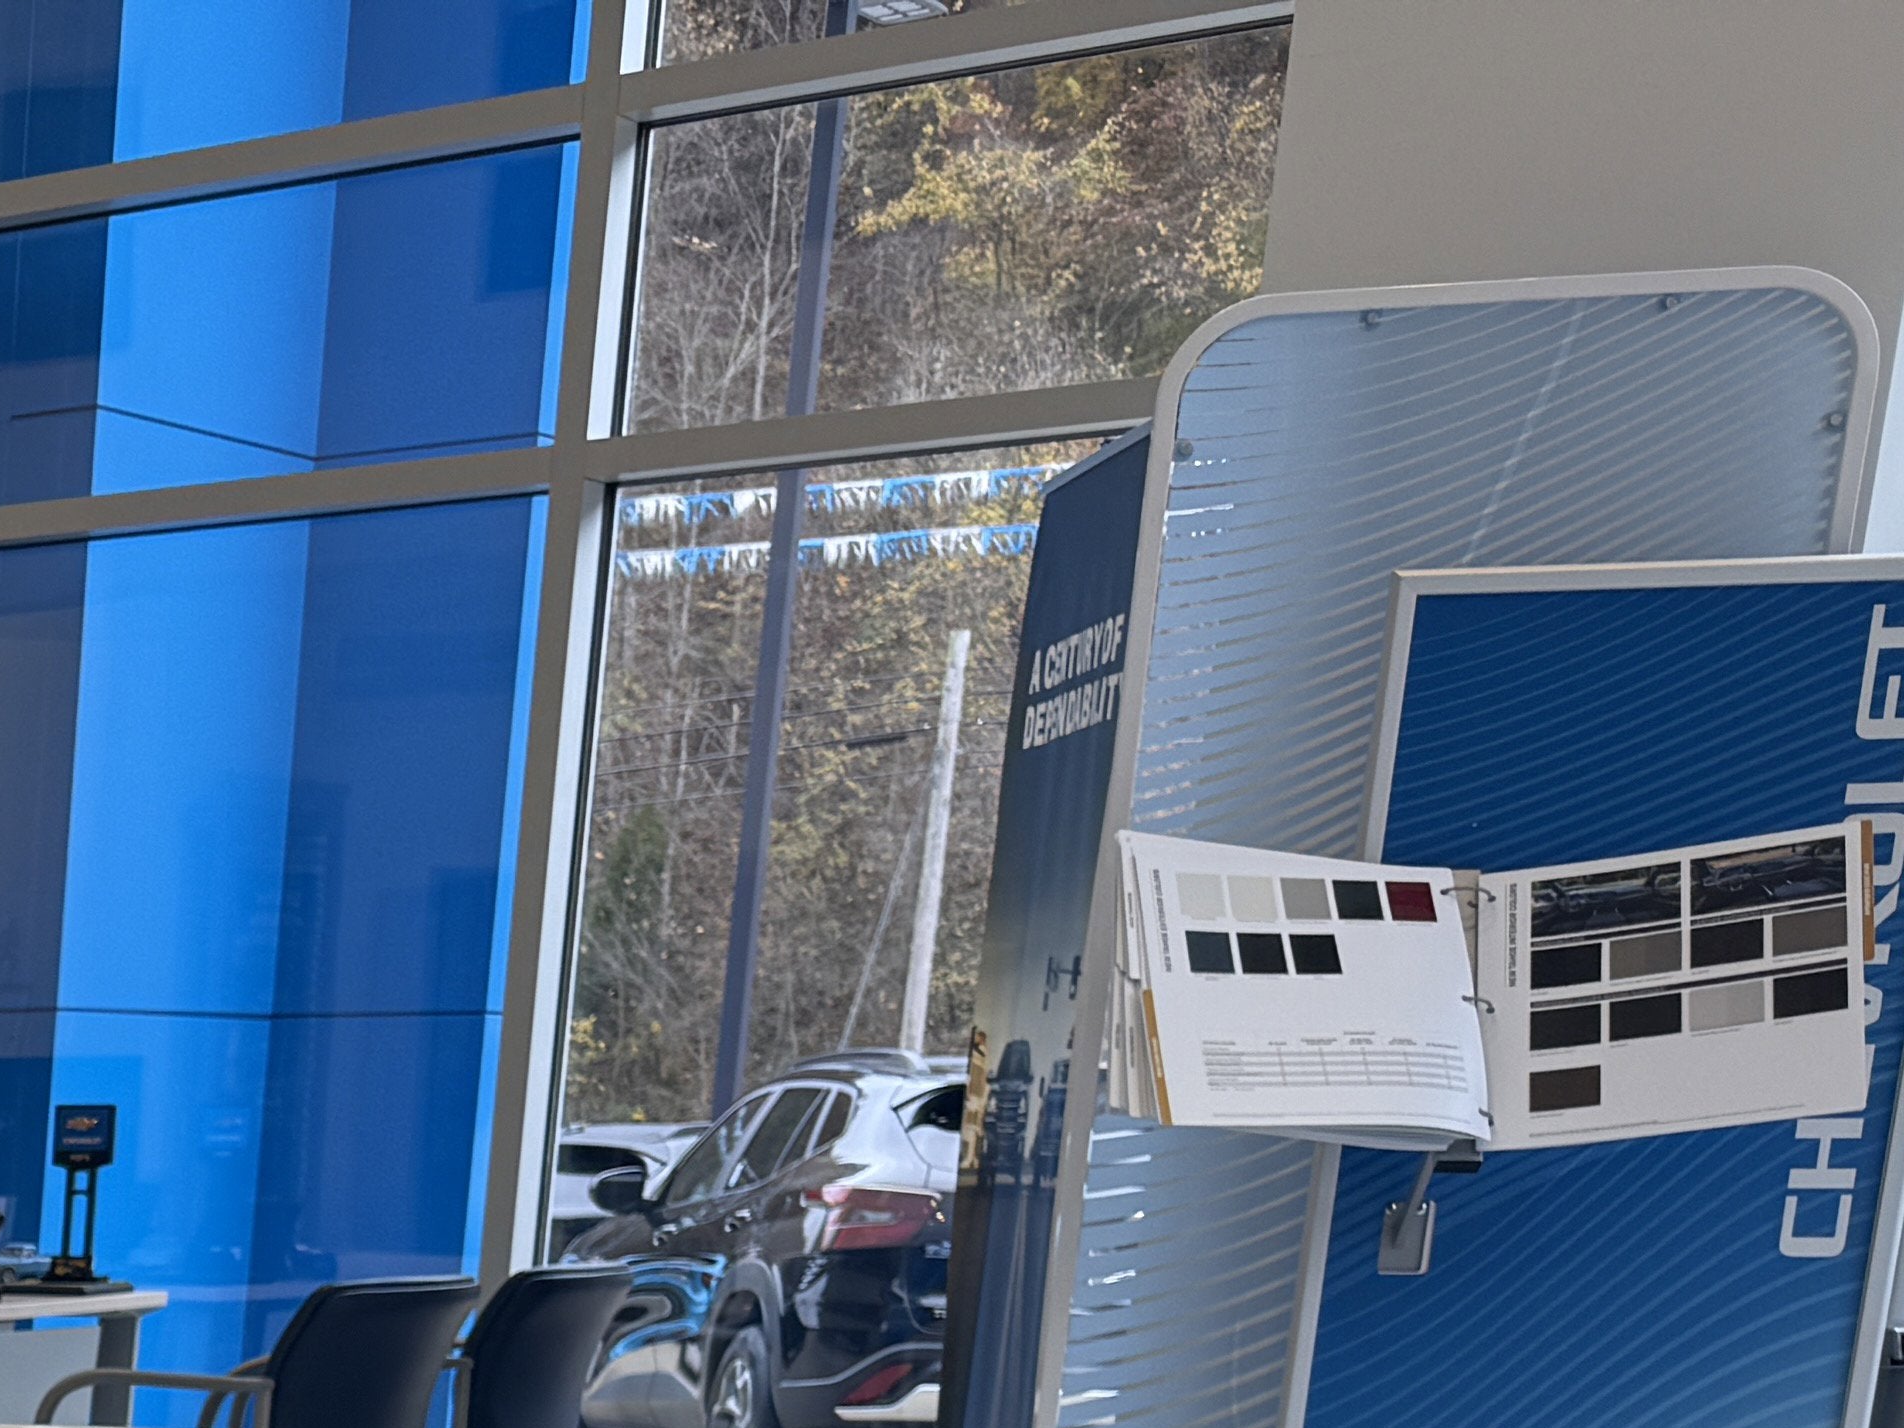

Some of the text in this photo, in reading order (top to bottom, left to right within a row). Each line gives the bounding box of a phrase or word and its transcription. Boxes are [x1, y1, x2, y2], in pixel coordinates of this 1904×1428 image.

[1029, 613, 1125, 695] A CENTURY OF
[1022, 672, 1123, 750] DEPENDABILIT
[1779, 604, 1904, 1257] CHOLET
